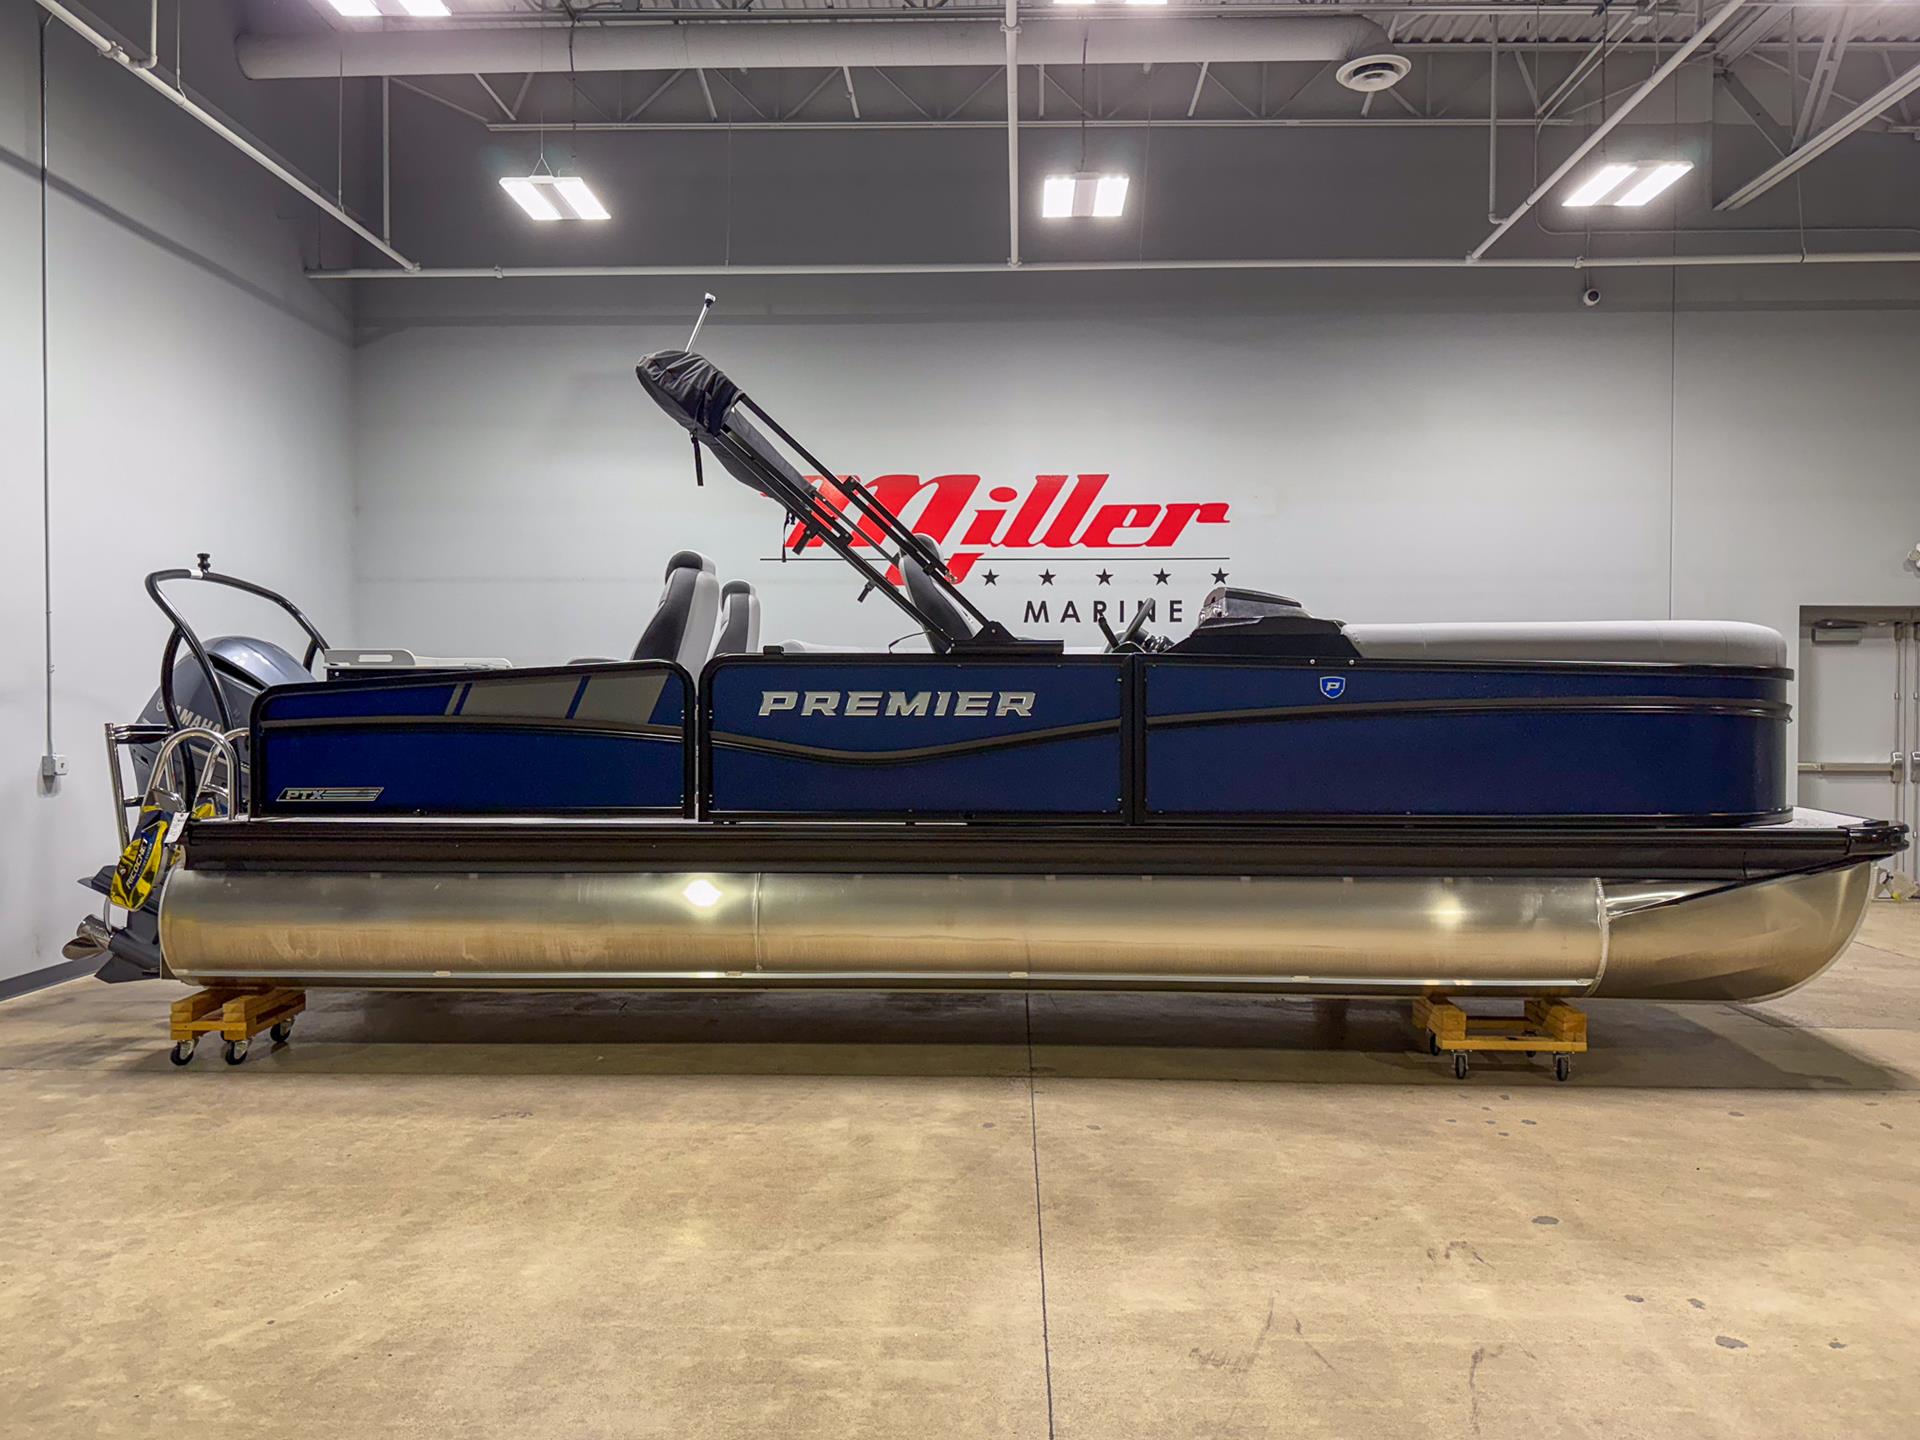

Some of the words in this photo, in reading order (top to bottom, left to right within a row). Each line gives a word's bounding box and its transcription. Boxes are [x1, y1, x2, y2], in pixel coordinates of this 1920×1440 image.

[760, 474, 1231, 586] Miller
[1023, 600, 1183, 623] MARINE
[1326, 682, 1341, 691] P
[758, 691, 1037, 718] PREMIER
[286, 790, 324, 800] PTX
